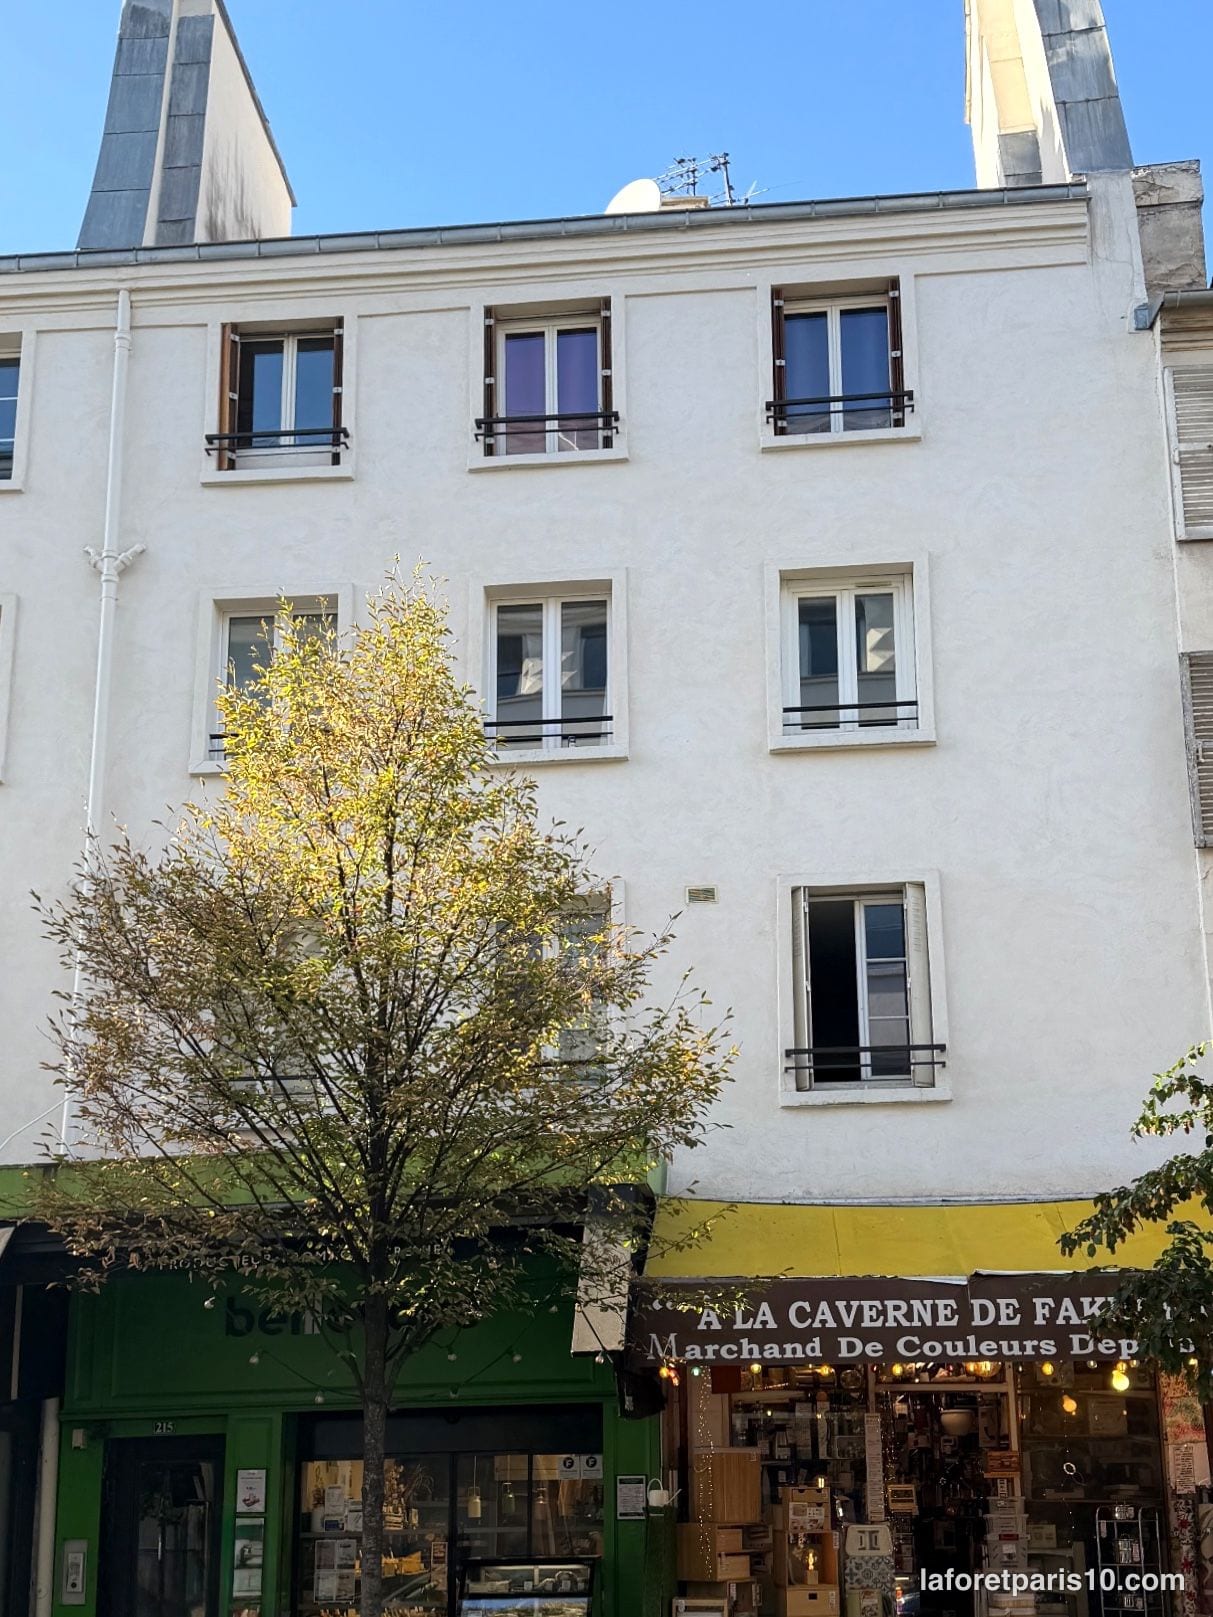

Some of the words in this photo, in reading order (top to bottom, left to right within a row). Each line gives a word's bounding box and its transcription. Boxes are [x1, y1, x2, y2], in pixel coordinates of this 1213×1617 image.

[733, 1301, 778, 1330] LA
[788, 1299, 958, 1329] CAVERNE
[971, 1298, 1021, 1326] DE
[647, 1332, 821, 1360] Marchand
[838, 1338, 884, 1359] De
[897, 1334, 1056, 1358] Couleurs
[155, 1422, 174, 1433] 215
